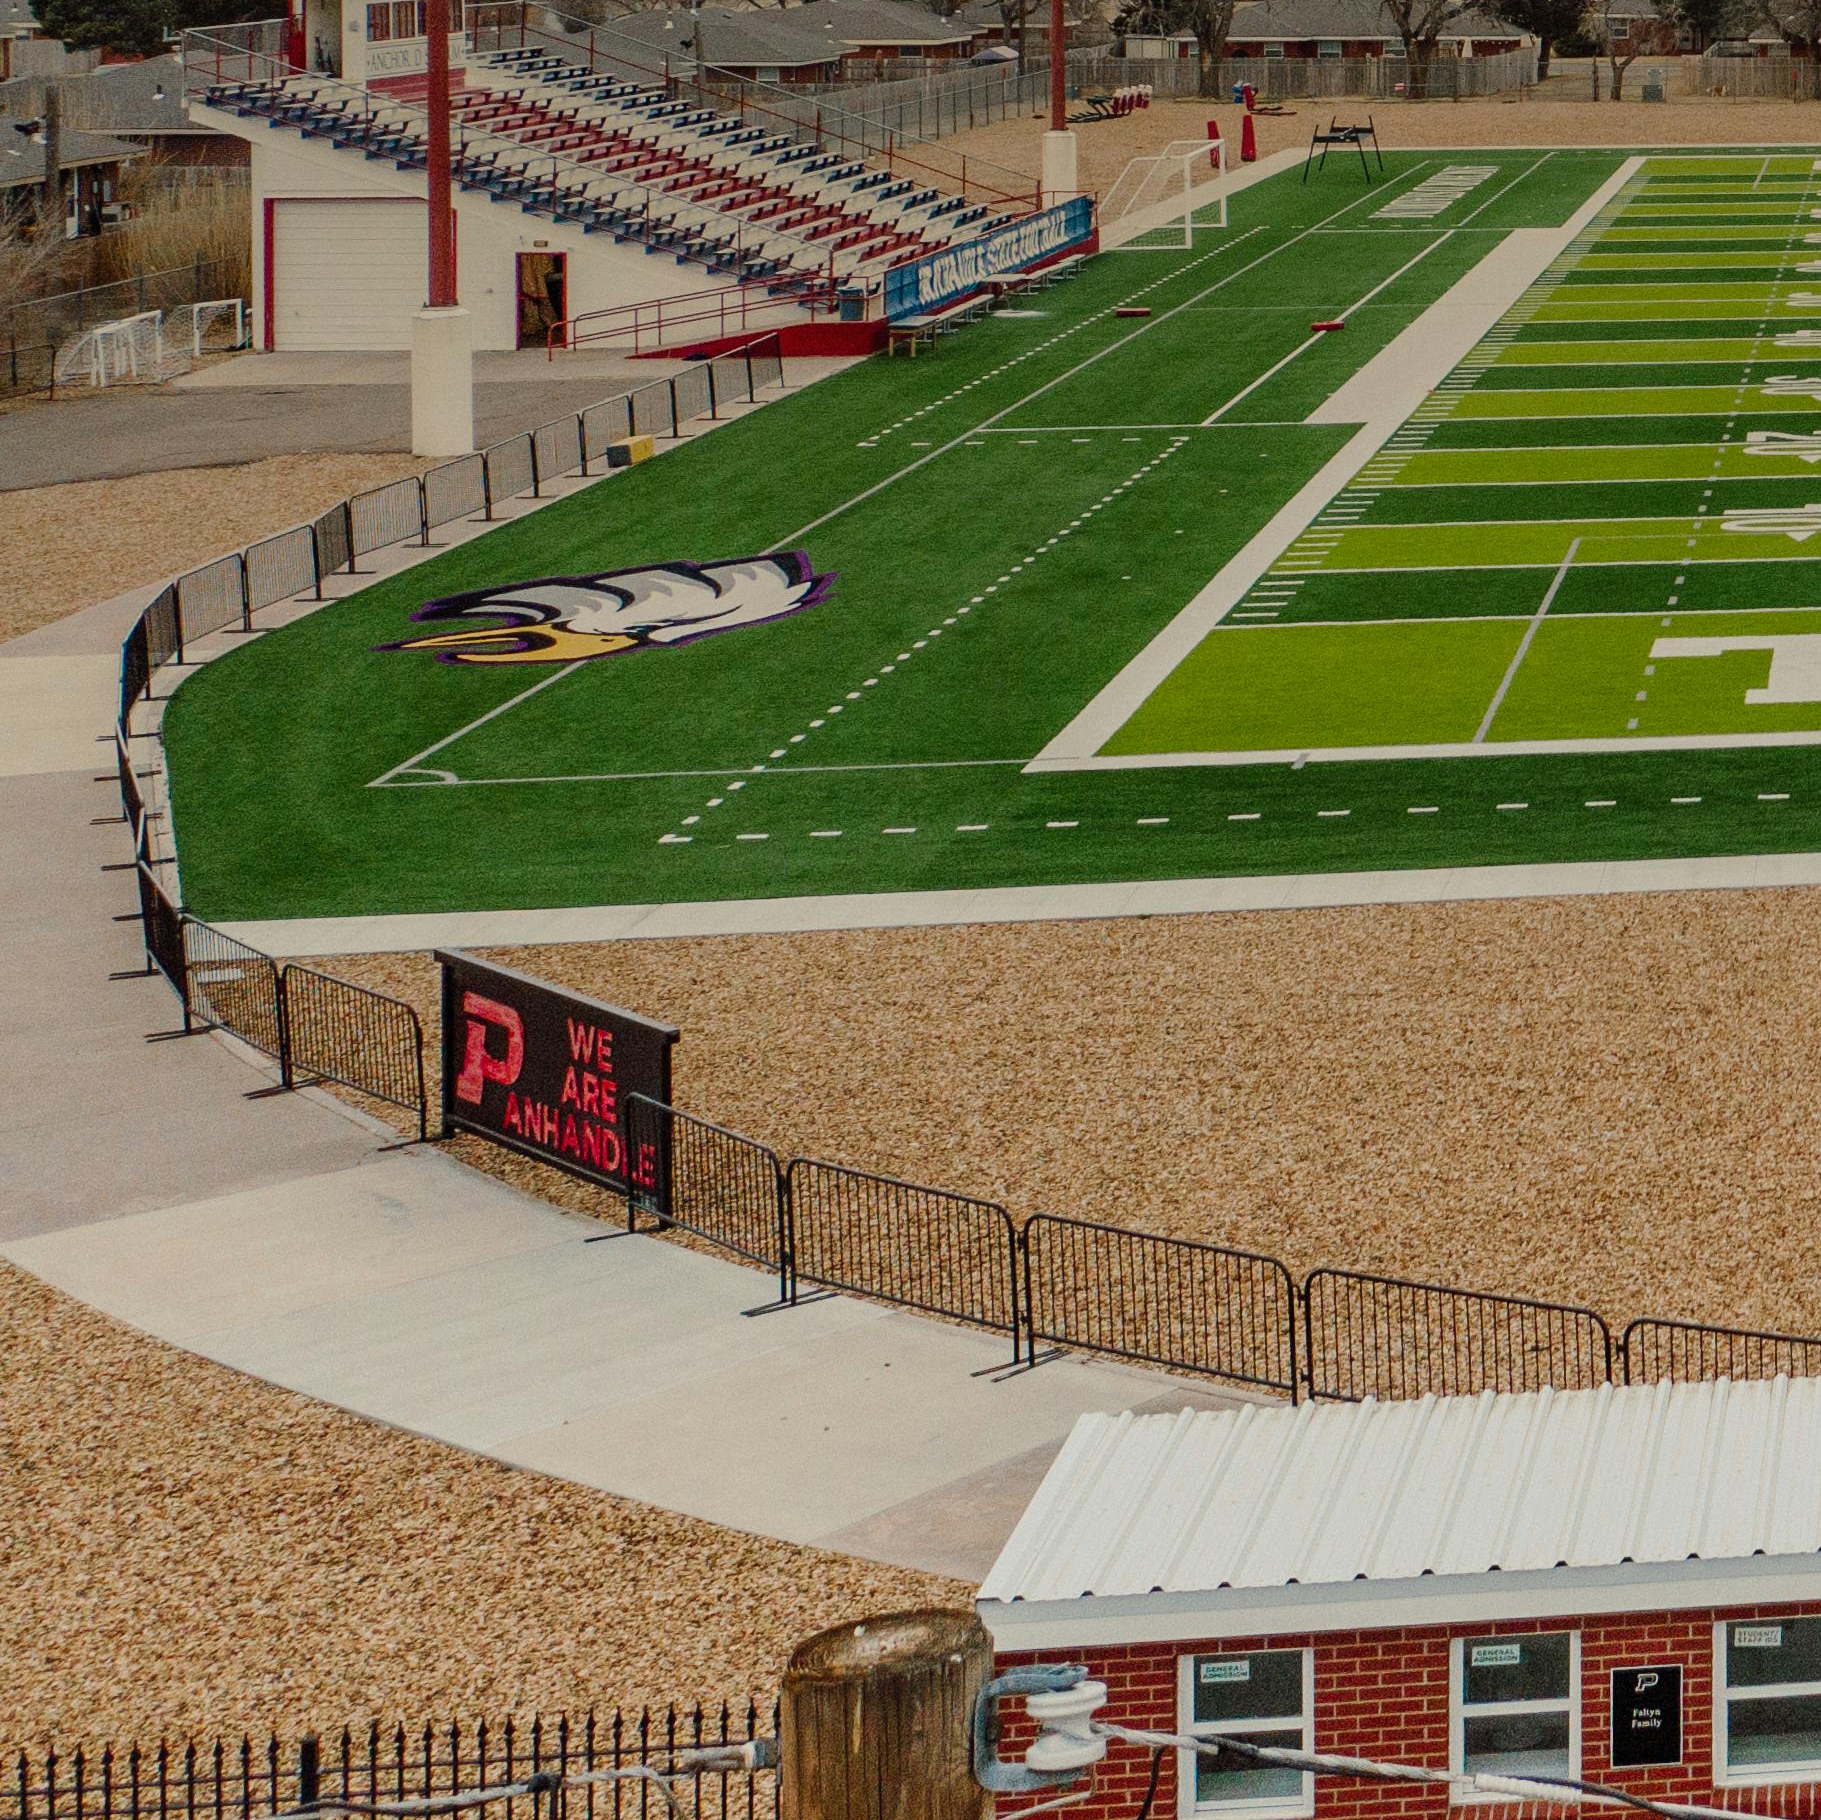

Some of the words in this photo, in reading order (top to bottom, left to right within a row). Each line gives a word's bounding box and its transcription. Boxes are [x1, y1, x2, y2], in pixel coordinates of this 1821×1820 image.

[455, 991, 524, 1105] P
[566, 1017, 613, 1074] WE
[561, 1065, 618, 1124] ARE
[1473, 1654, 1518, 1663] ADMISSION
[1477, 1648, 1515, 1656] GENERAL
[1206, 1664, 1245, 1673] GENERAL
[1635, 1673, 1659, 1692] P
[1631, 1718, 1663, 1729] Family
